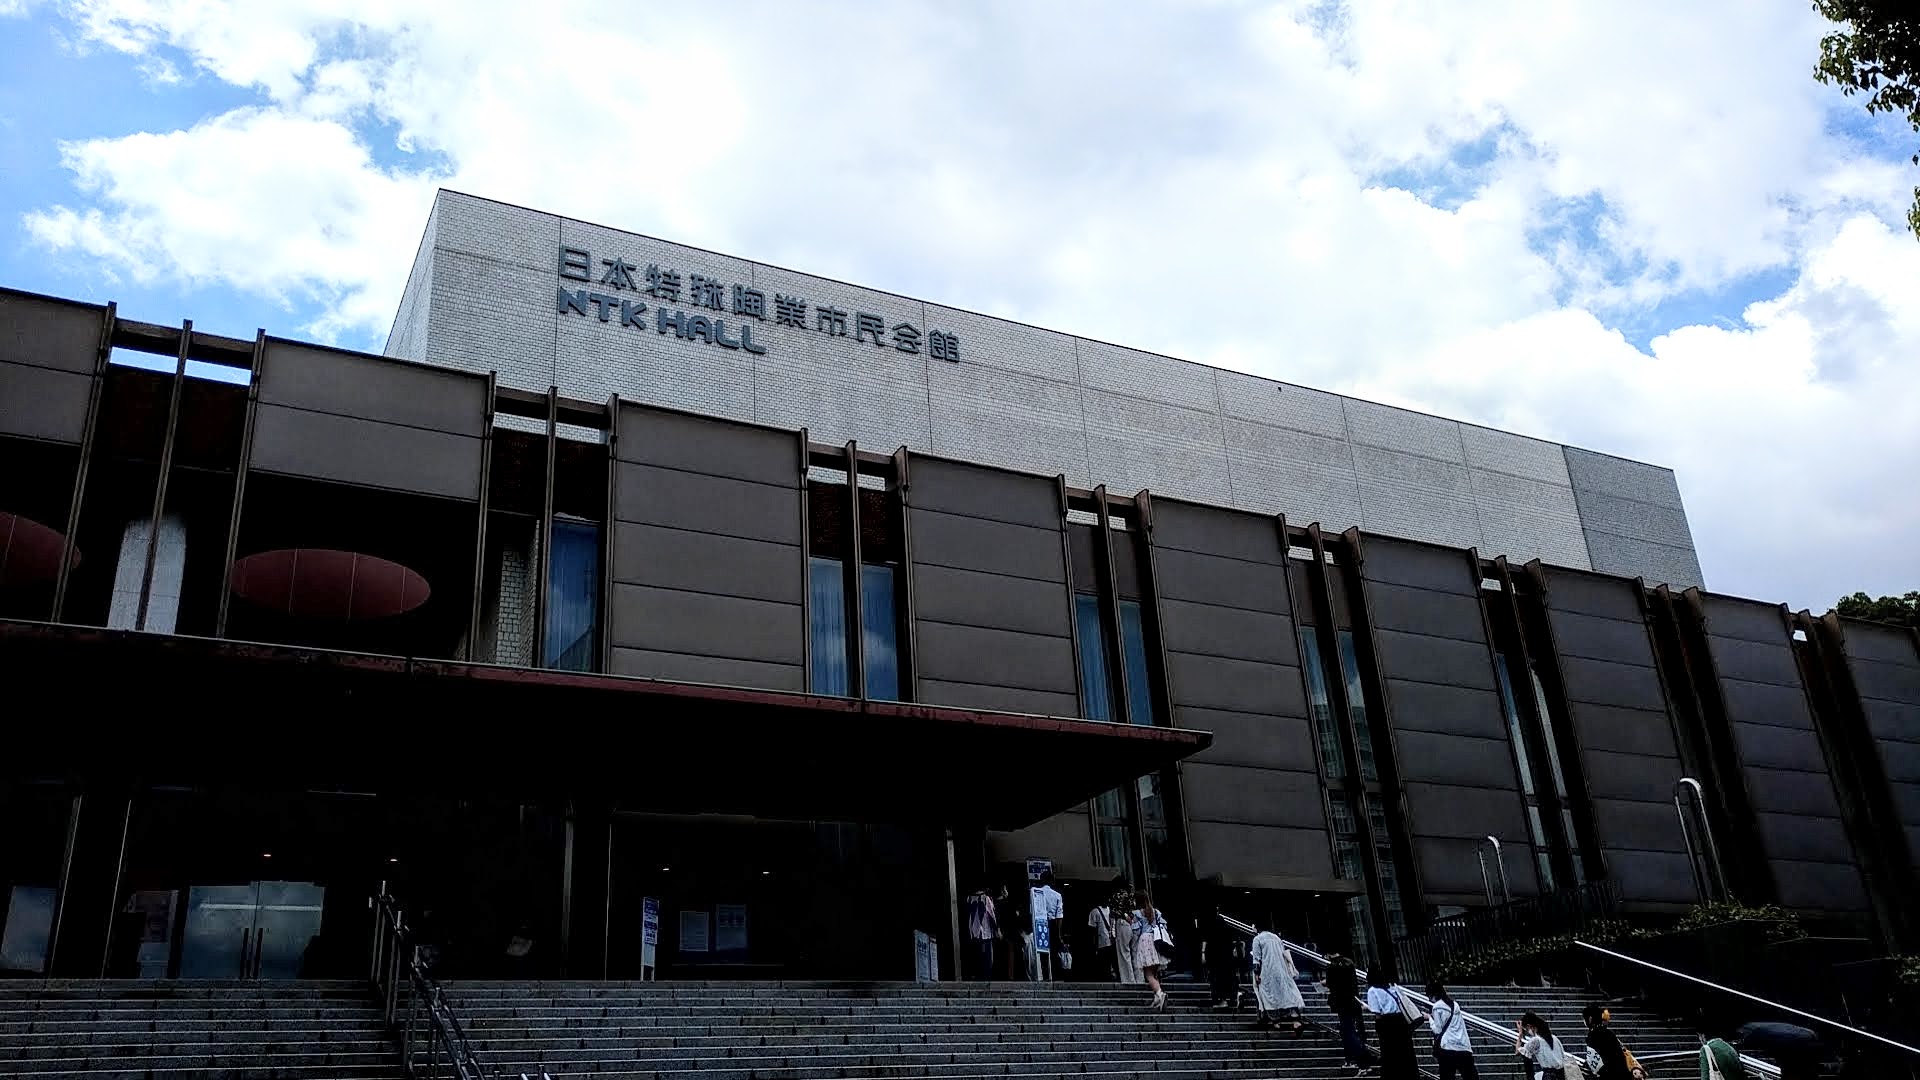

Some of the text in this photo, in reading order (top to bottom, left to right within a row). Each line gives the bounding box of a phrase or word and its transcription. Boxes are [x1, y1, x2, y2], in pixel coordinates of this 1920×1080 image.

[560, 288, 766, 355] NTK HALL
[561, 247, 960, 362] 日本特殊陶業市民会館
